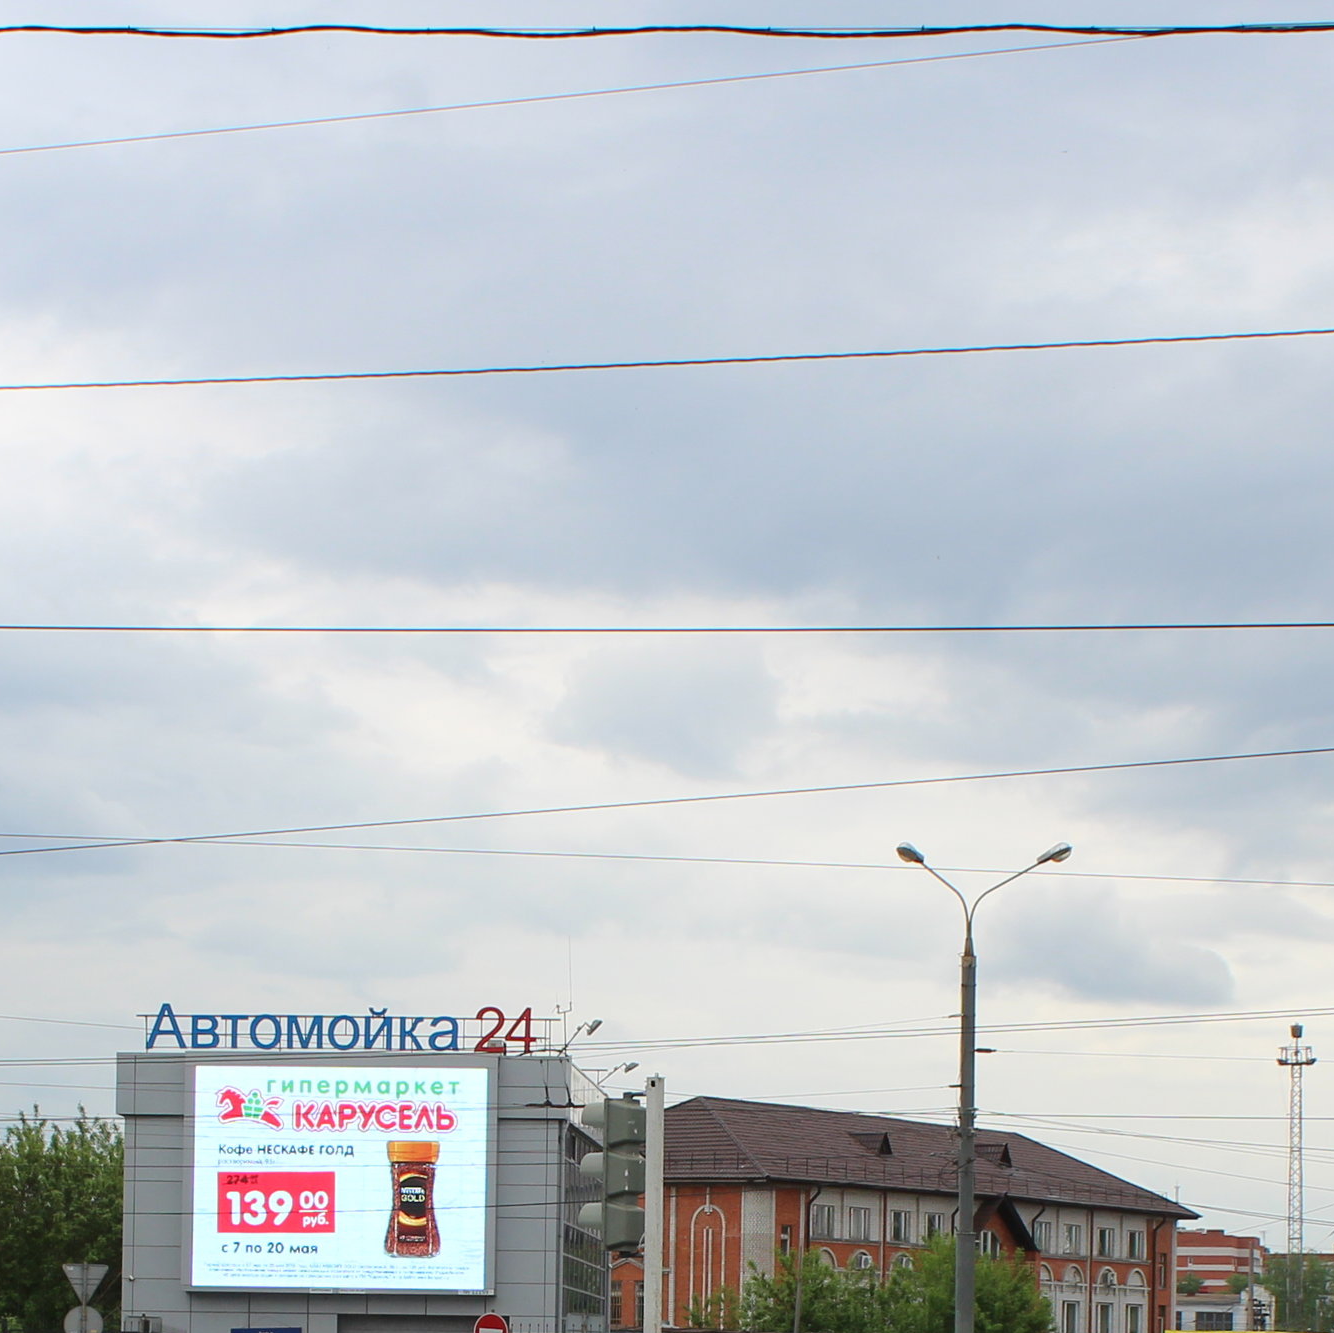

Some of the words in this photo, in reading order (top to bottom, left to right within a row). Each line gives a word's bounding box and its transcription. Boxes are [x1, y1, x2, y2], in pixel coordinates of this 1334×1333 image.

[146, 1003, 459, 1051] Автомойка
[474, 1006, 537, 1053] 24
[267, 1080, 460, 1098] гипермаркет
[294, 1103, 455, 1131] КАРУСЕЛЬ
[218, 1144, 253, 1156] Кофе
[257, 1144, 315, 1155] НЕСКАФЕ
[319, 1145, 355, 1157] ГОЛД
[401, 1194, 426, 1203] GOLD
[226, 1190, 294, 1226] 139
[299, 1191, 329, 1209] 00
[302, 1213, 329, 1228] руб.
[221, 1244, 228, 1253] с
[233, 1242, 241, 1253] 7
[246, 1244, 262, 1253] по
[267, 1242, 284, 1254] 20
[289, 1244, 318, 1254] мая
